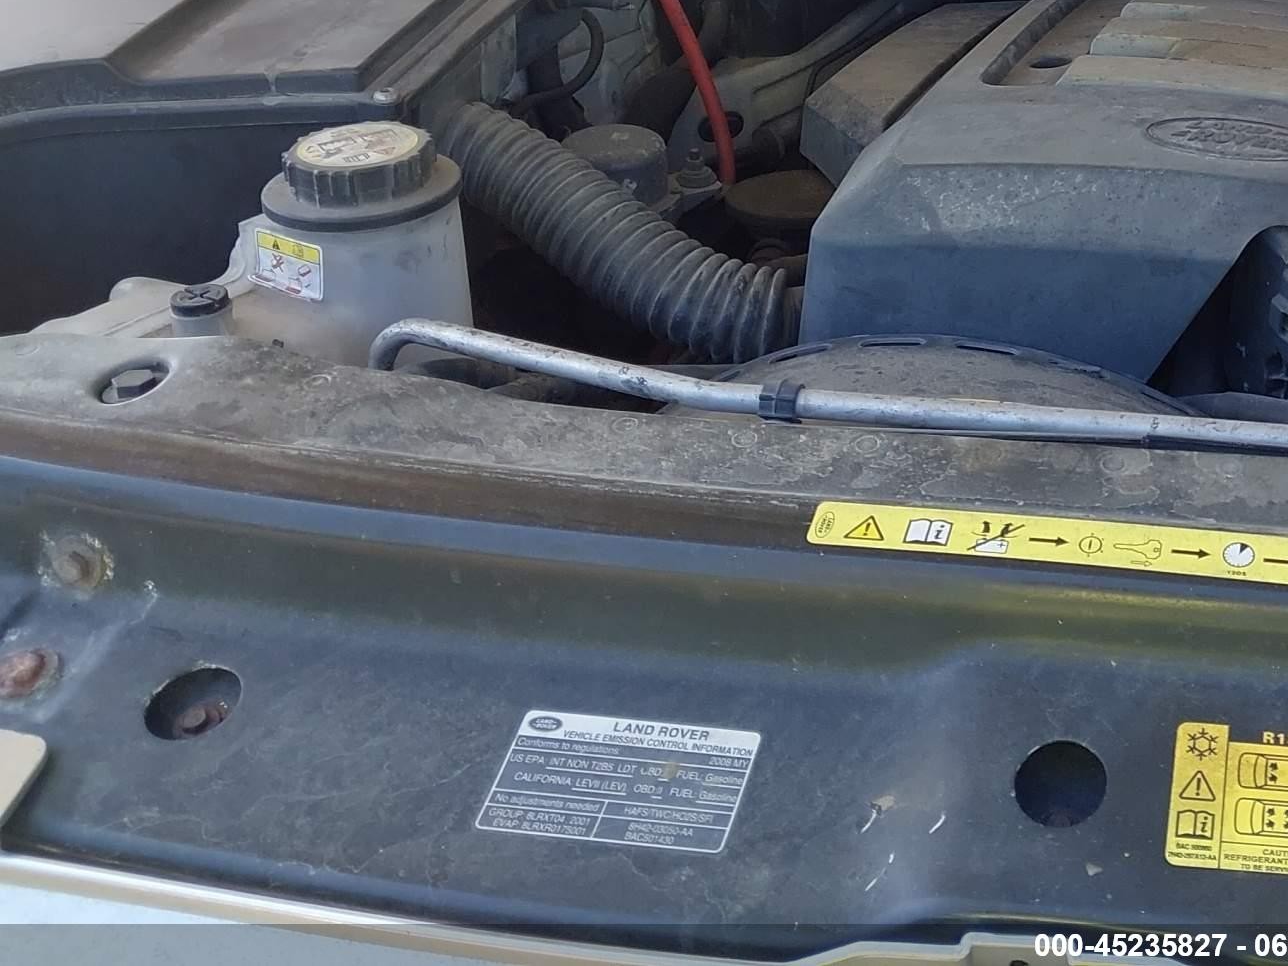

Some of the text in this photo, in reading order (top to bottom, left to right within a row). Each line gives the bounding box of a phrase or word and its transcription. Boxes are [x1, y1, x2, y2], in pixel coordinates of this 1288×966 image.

[613, 721, 710, 740] LAND ROVER
[518, 737, 559, 748] Conforms
[561, 742, 570, 750] to
[563, 730, 753, 756] VEHICLE EMISSION CONTROL INFORMATION
[510, 754, 525, 762] US
[549, 757, 566, 766] INT
[566, 759, 589, 769] NON
[617, 764, 637, 773] LDT
[705, 773, 744, 784] Gasoline
[734, 758, 749, 768] MY
[495, 794, 600, 812] No adjustments needed
[699, 791, 738, 802] Gasoline
[1224, 854, 1288, 866] REFRIGERANT
